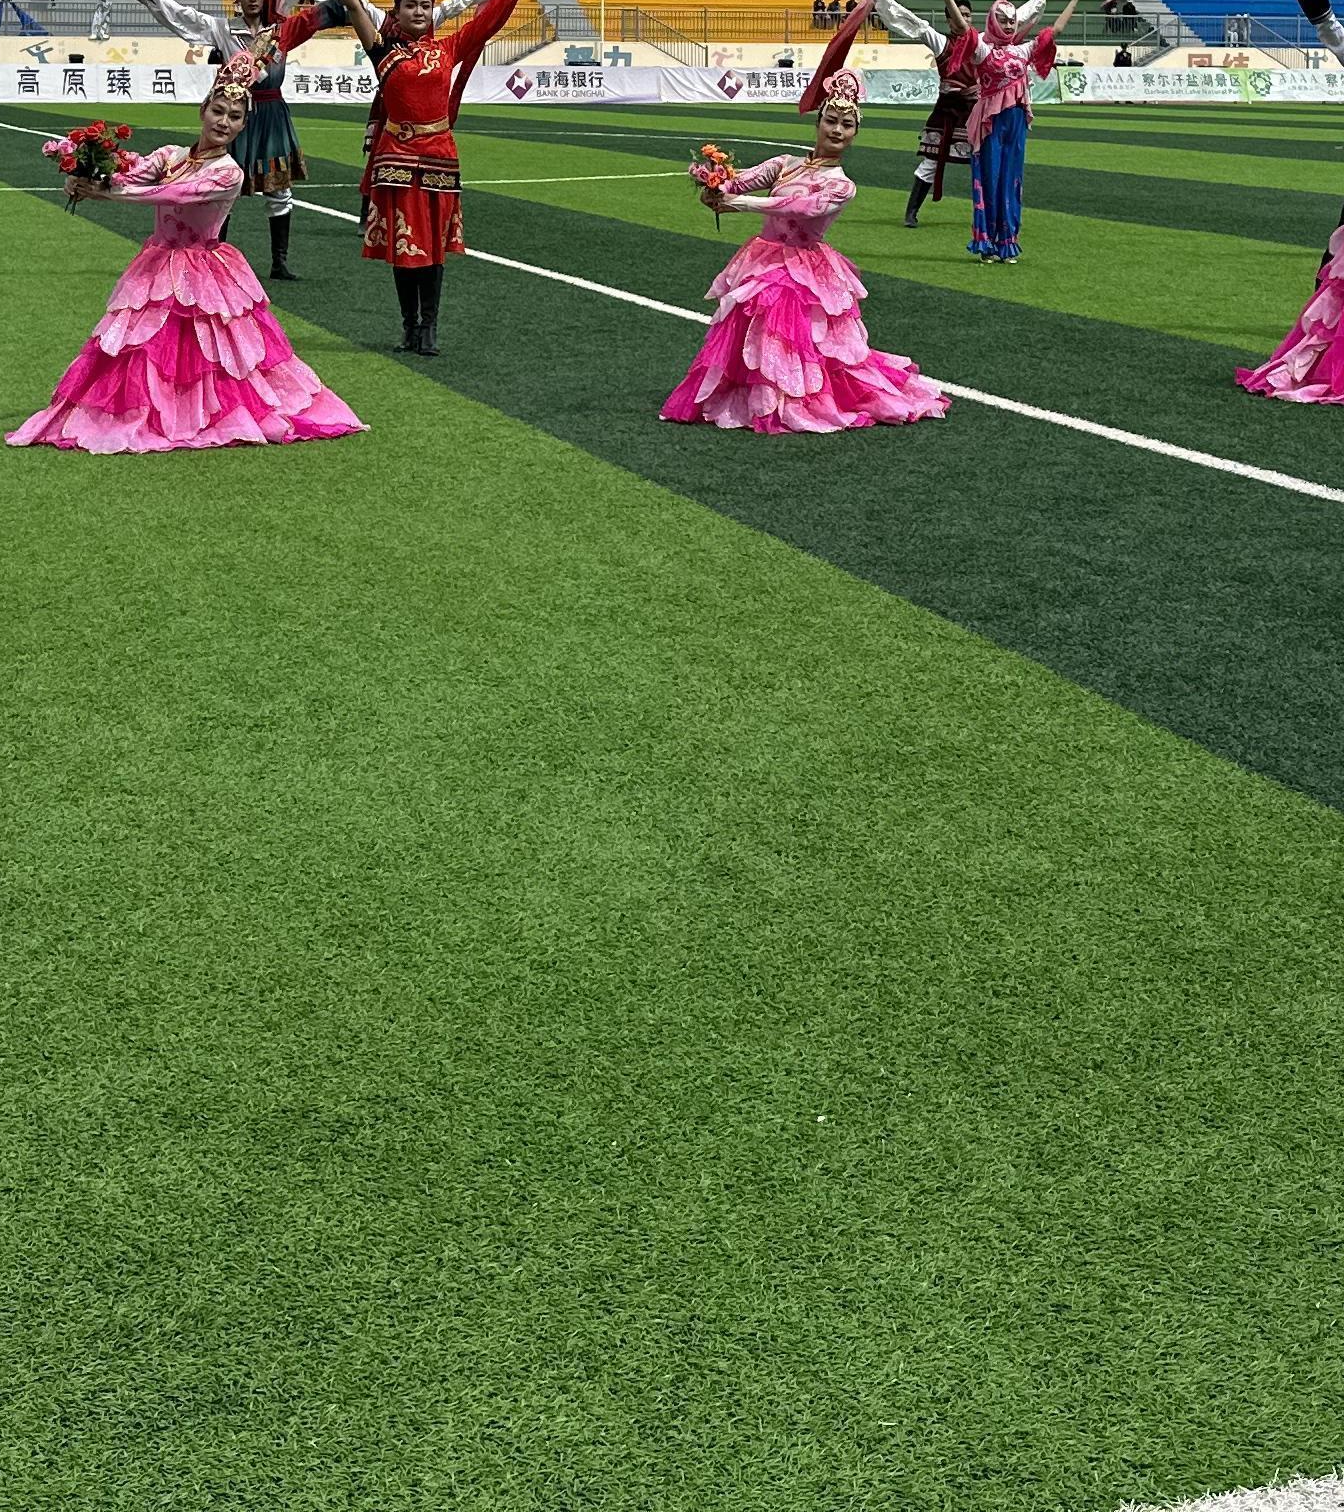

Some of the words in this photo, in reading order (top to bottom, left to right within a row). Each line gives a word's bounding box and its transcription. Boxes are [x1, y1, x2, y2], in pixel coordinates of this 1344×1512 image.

[16, 66, 177, 101] 高原臻品
[535, 70, 605, 89] 青海银行
[746, 72, 810, 89] 青海银行
[1142, 73, 1241, 88] 察尔汗盐湖景区
[536, 89, 559, 98] BANK
[560, 90, 570, 98] OF
[571, 89, 605, 98] QINGHAI
